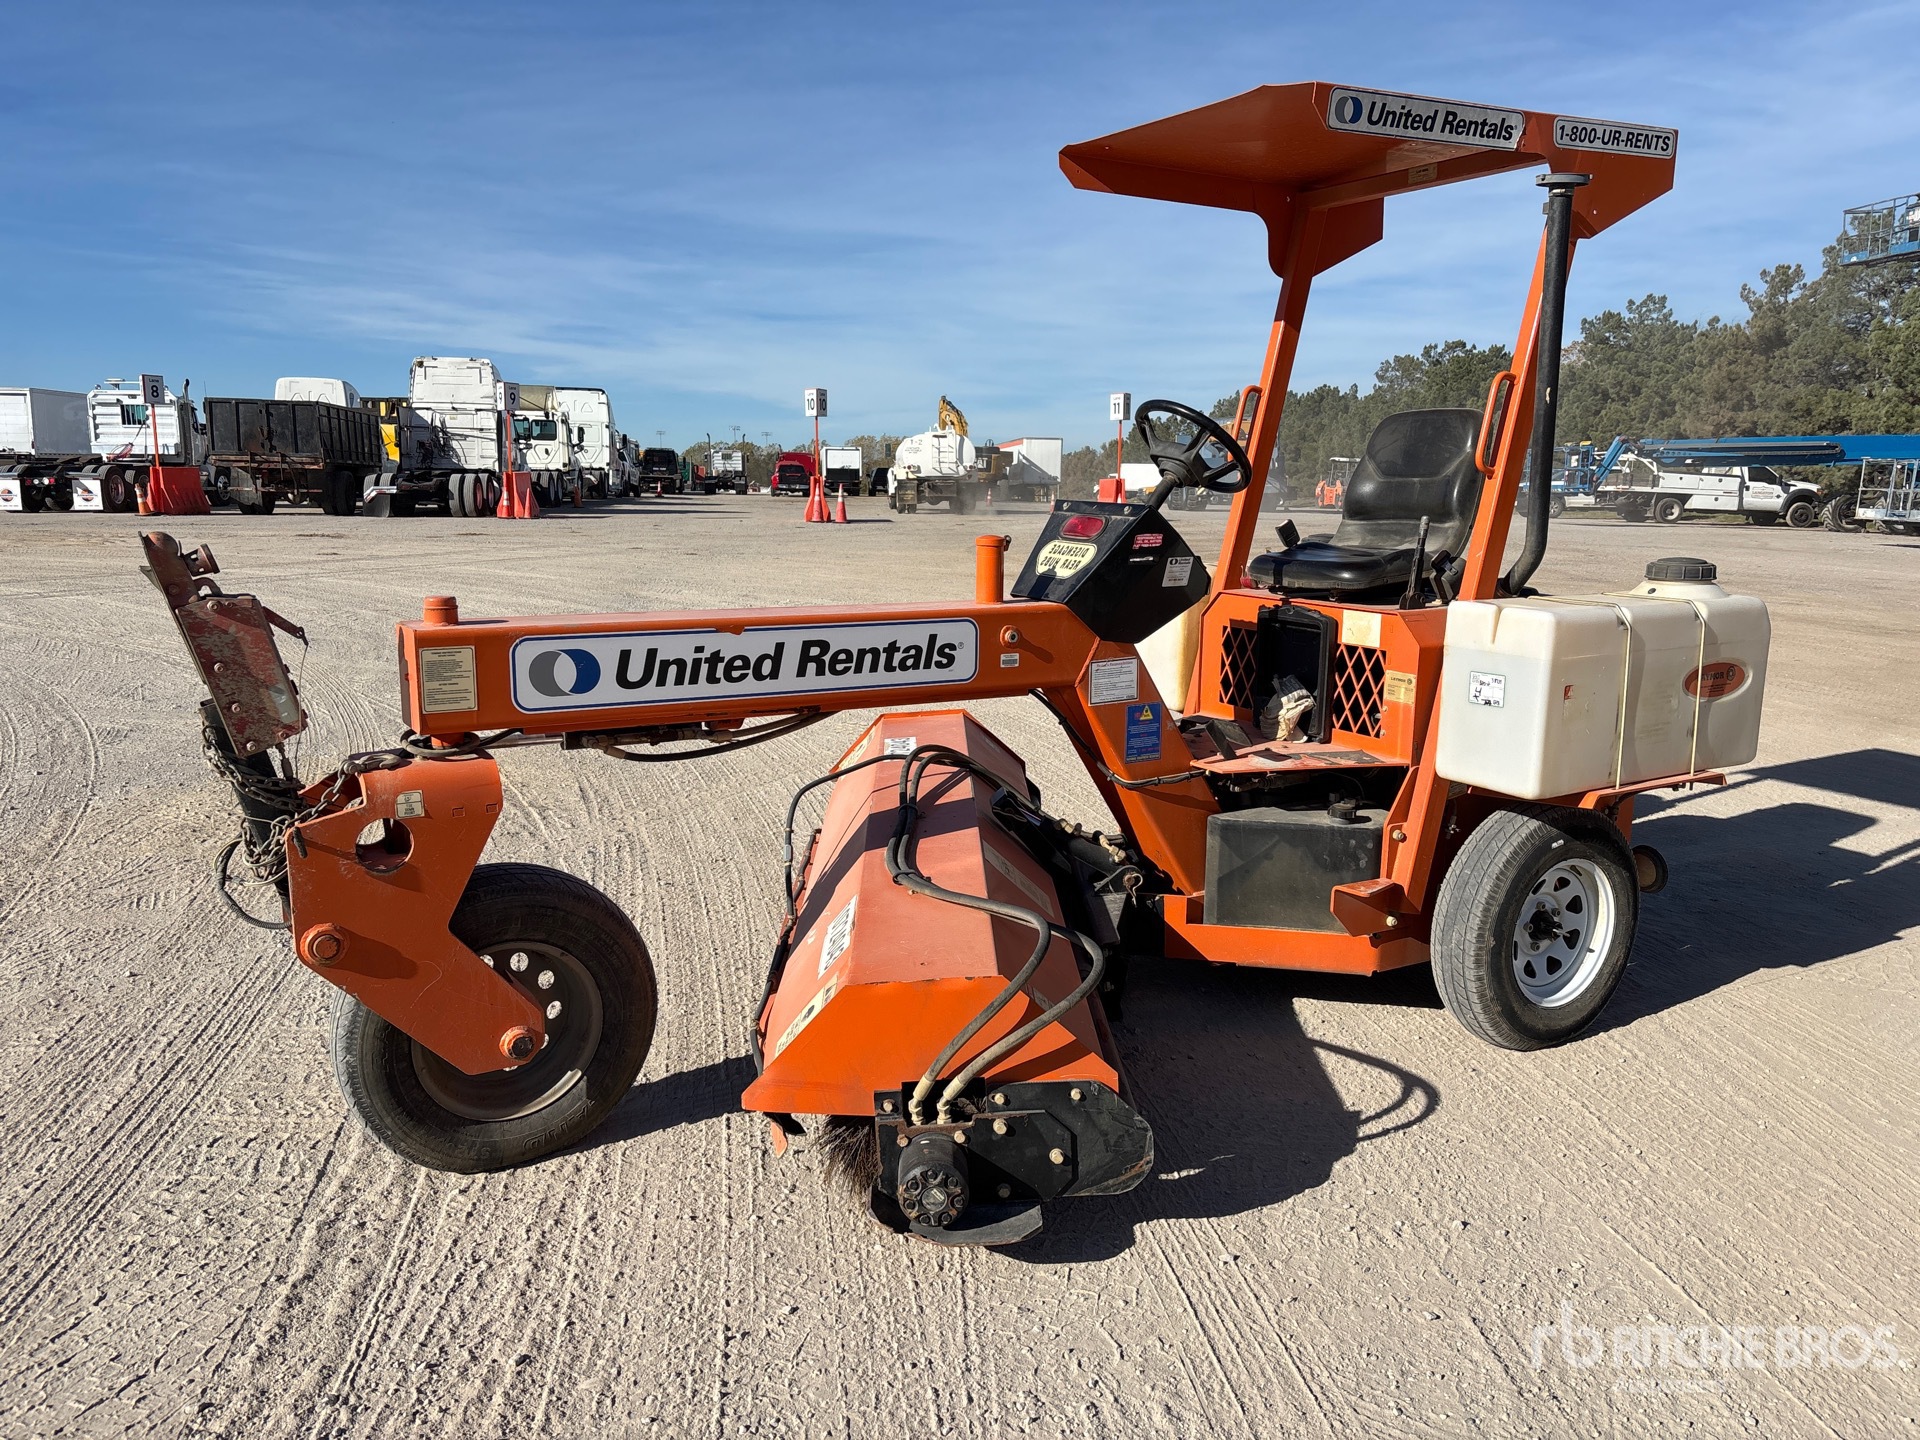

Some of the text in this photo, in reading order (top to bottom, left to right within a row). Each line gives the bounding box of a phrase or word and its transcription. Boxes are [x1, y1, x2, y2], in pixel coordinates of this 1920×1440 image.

[1367, 100, 1513, 141] United Rentals
[1559, 124, 1671, 152] 1-800-UR-RENTS
[151, 385, 159, 398] 8
[510, 392, 516, 405] 9
[807, 398, 815, 411] 10
[819, 398, 827, 411] 10
[1113, 402, 1121, 414] 11
[616, 633, 957, 690] United Rentals
